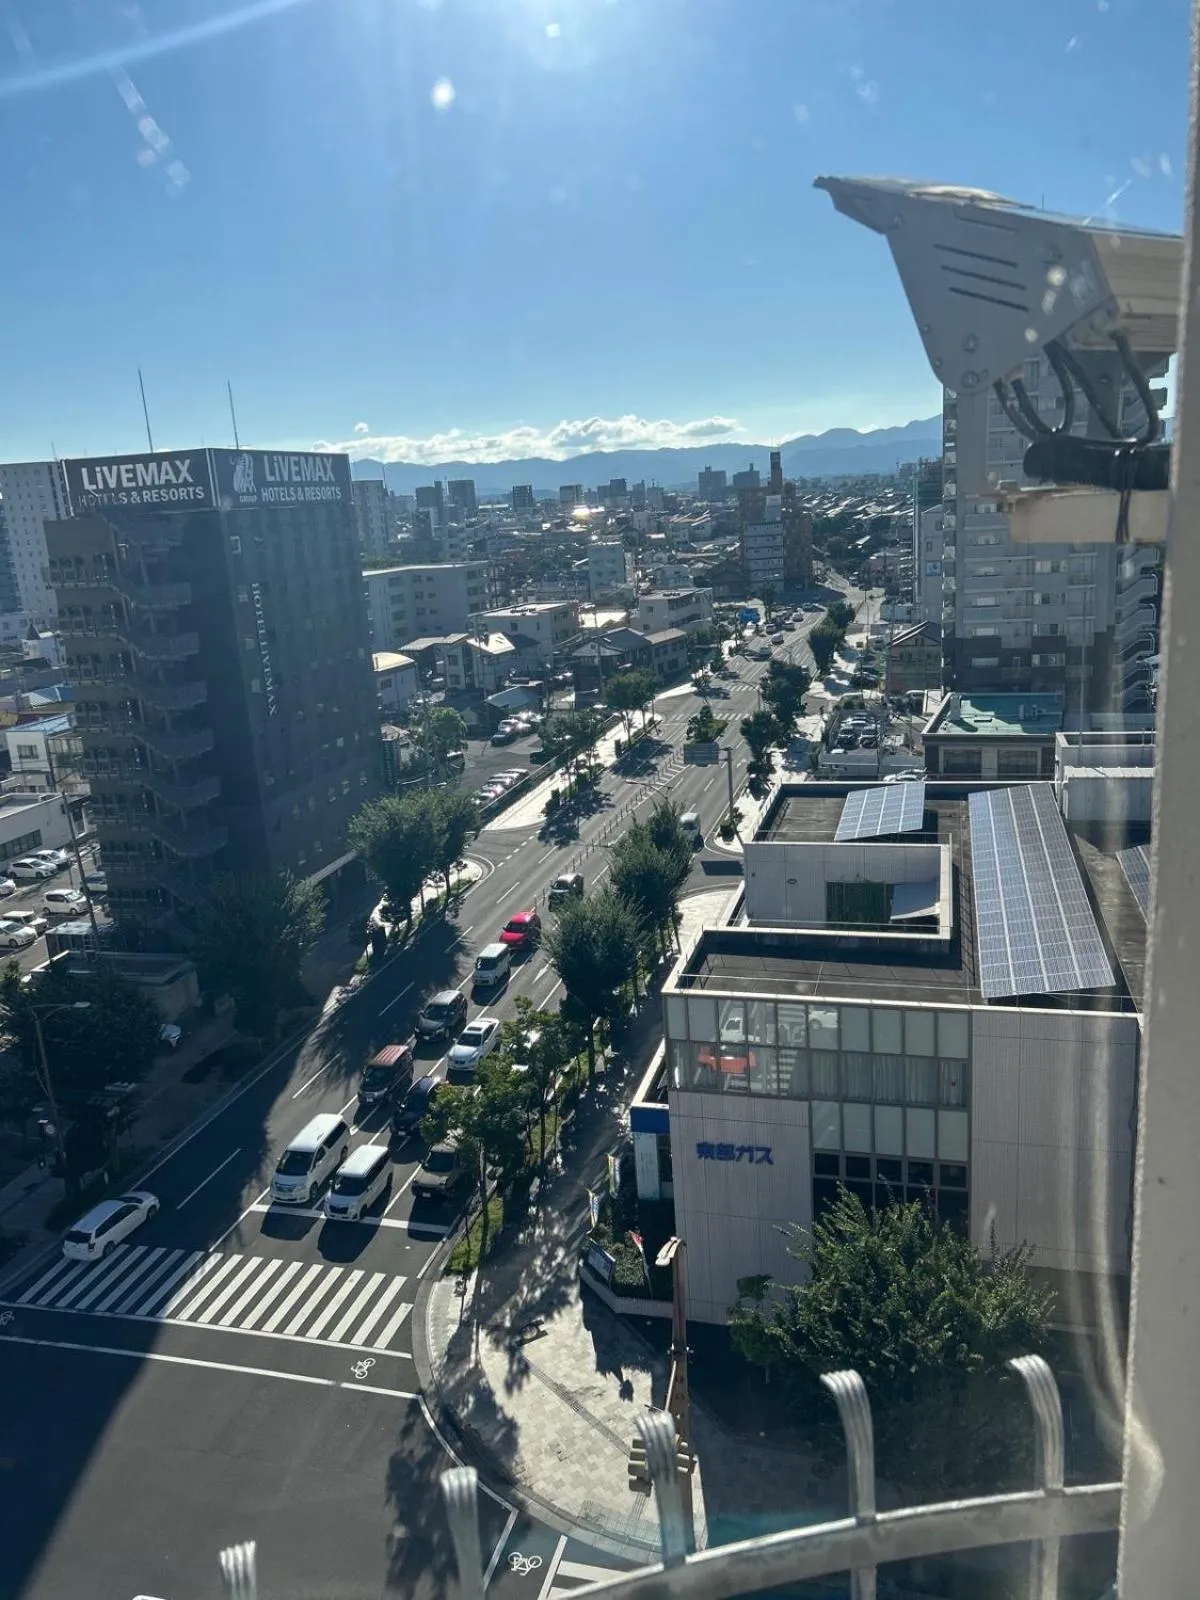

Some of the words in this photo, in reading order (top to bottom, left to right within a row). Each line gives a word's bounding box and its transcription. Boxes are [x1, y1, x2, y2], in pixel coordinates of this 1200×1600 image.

[131, 491, 142, 504] &
[142, 486, 205, 503] RESORTS
[239, 495, 258, 503] GROUP
[261, 486, 296, 502] HOTELS
[297, 487, 304, 501] &
[305, 486, 342, 501] RESORTS
